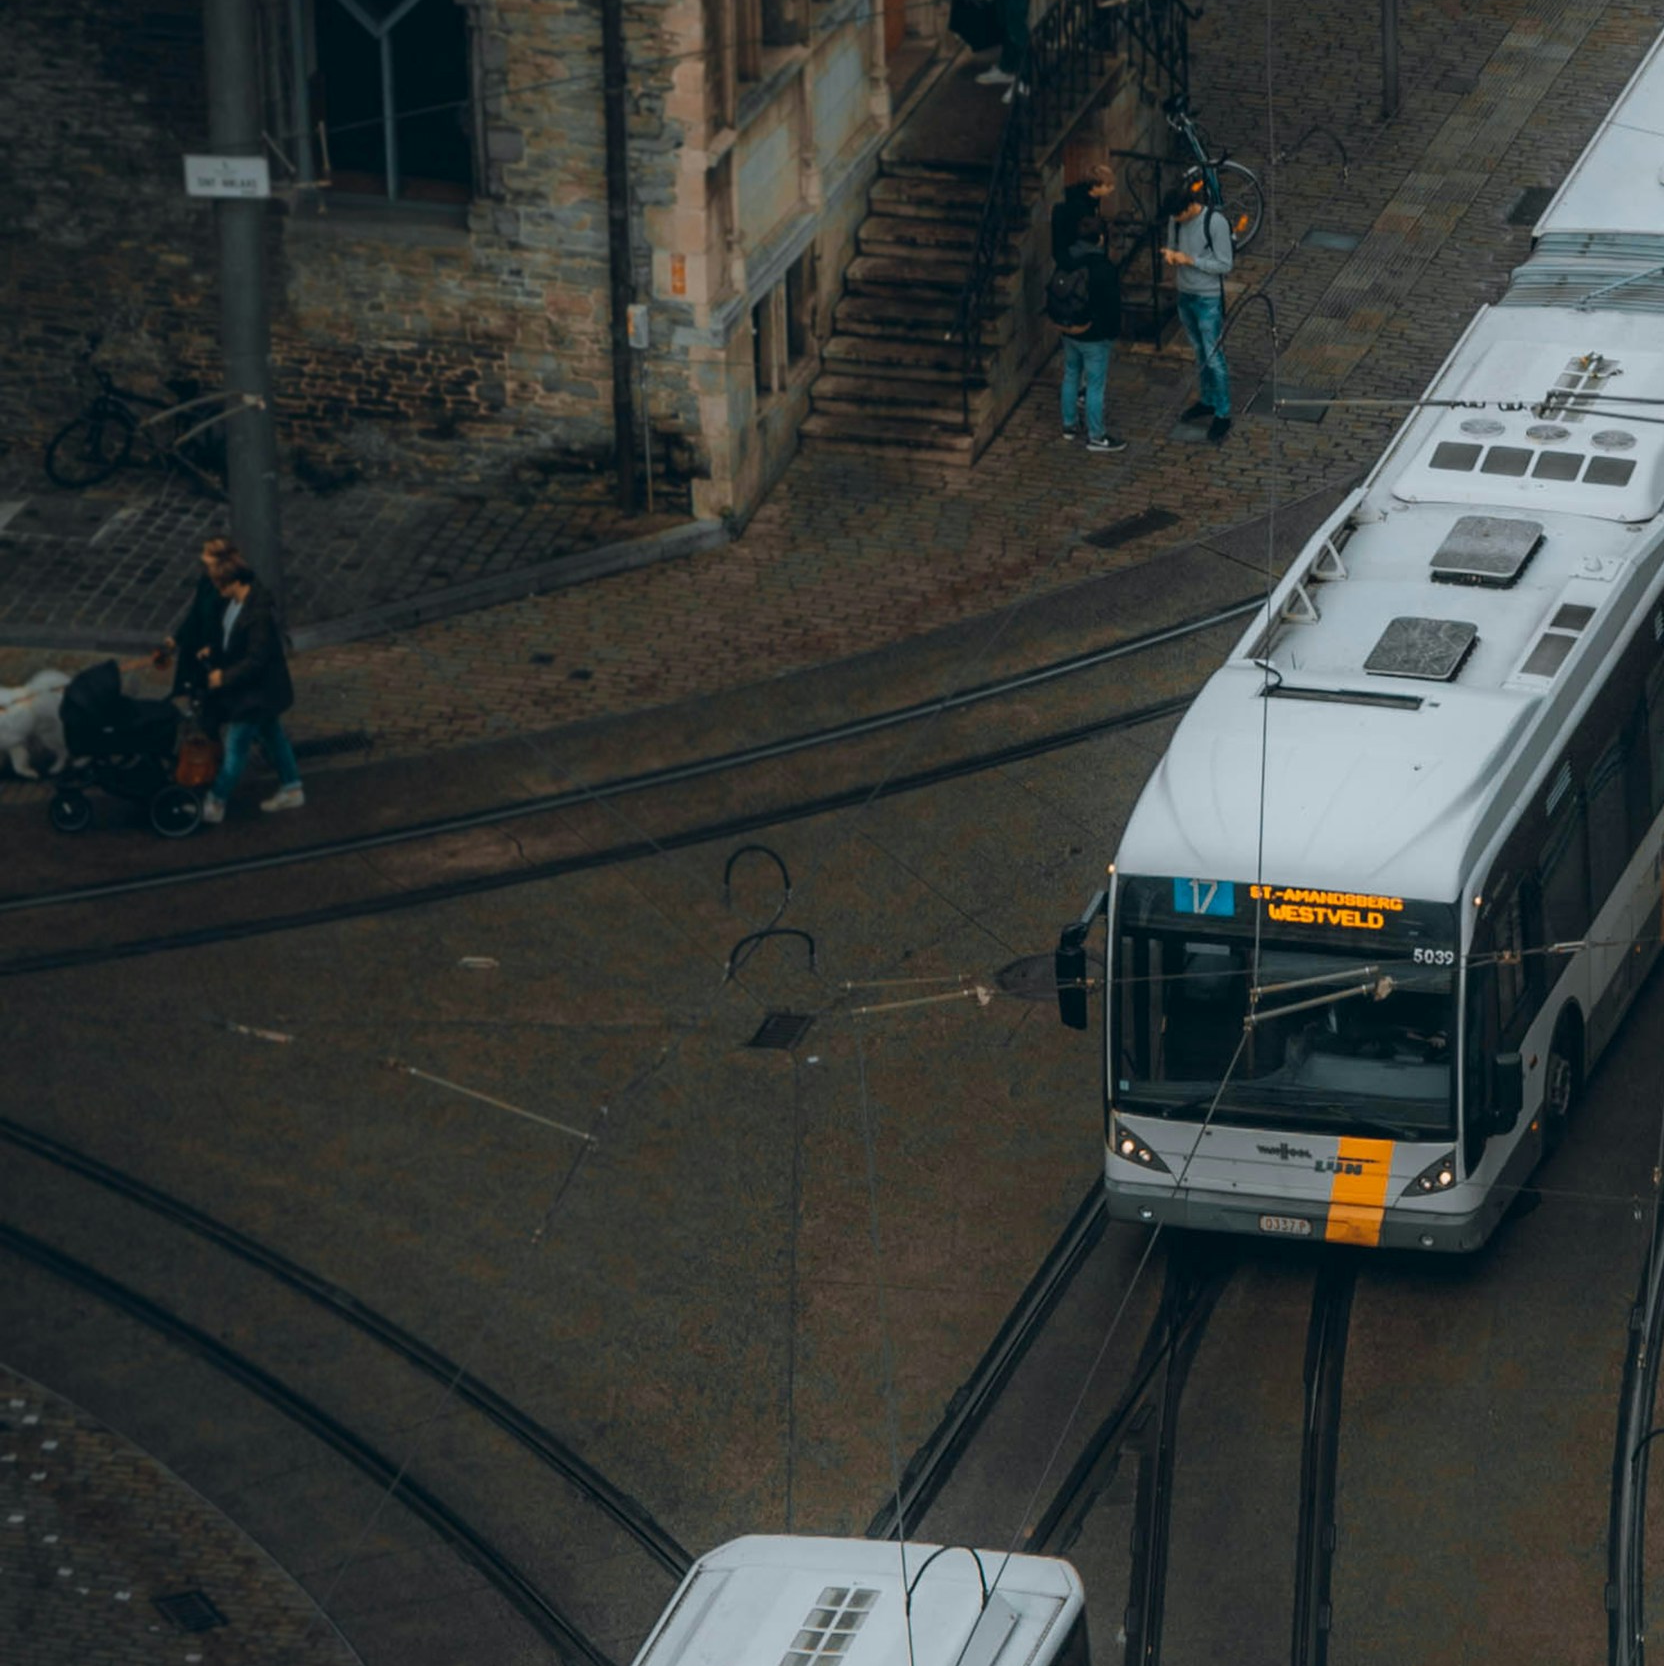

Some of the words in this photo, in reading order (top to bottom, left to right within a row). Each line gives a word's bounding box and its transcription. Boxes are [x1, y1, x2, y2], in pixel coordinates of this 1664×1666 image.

[1189, 878, 1218, 915] 17
[1268, 903, 1385, 930] WESTVELD
[1413, 948, 1454, 966] 5039
